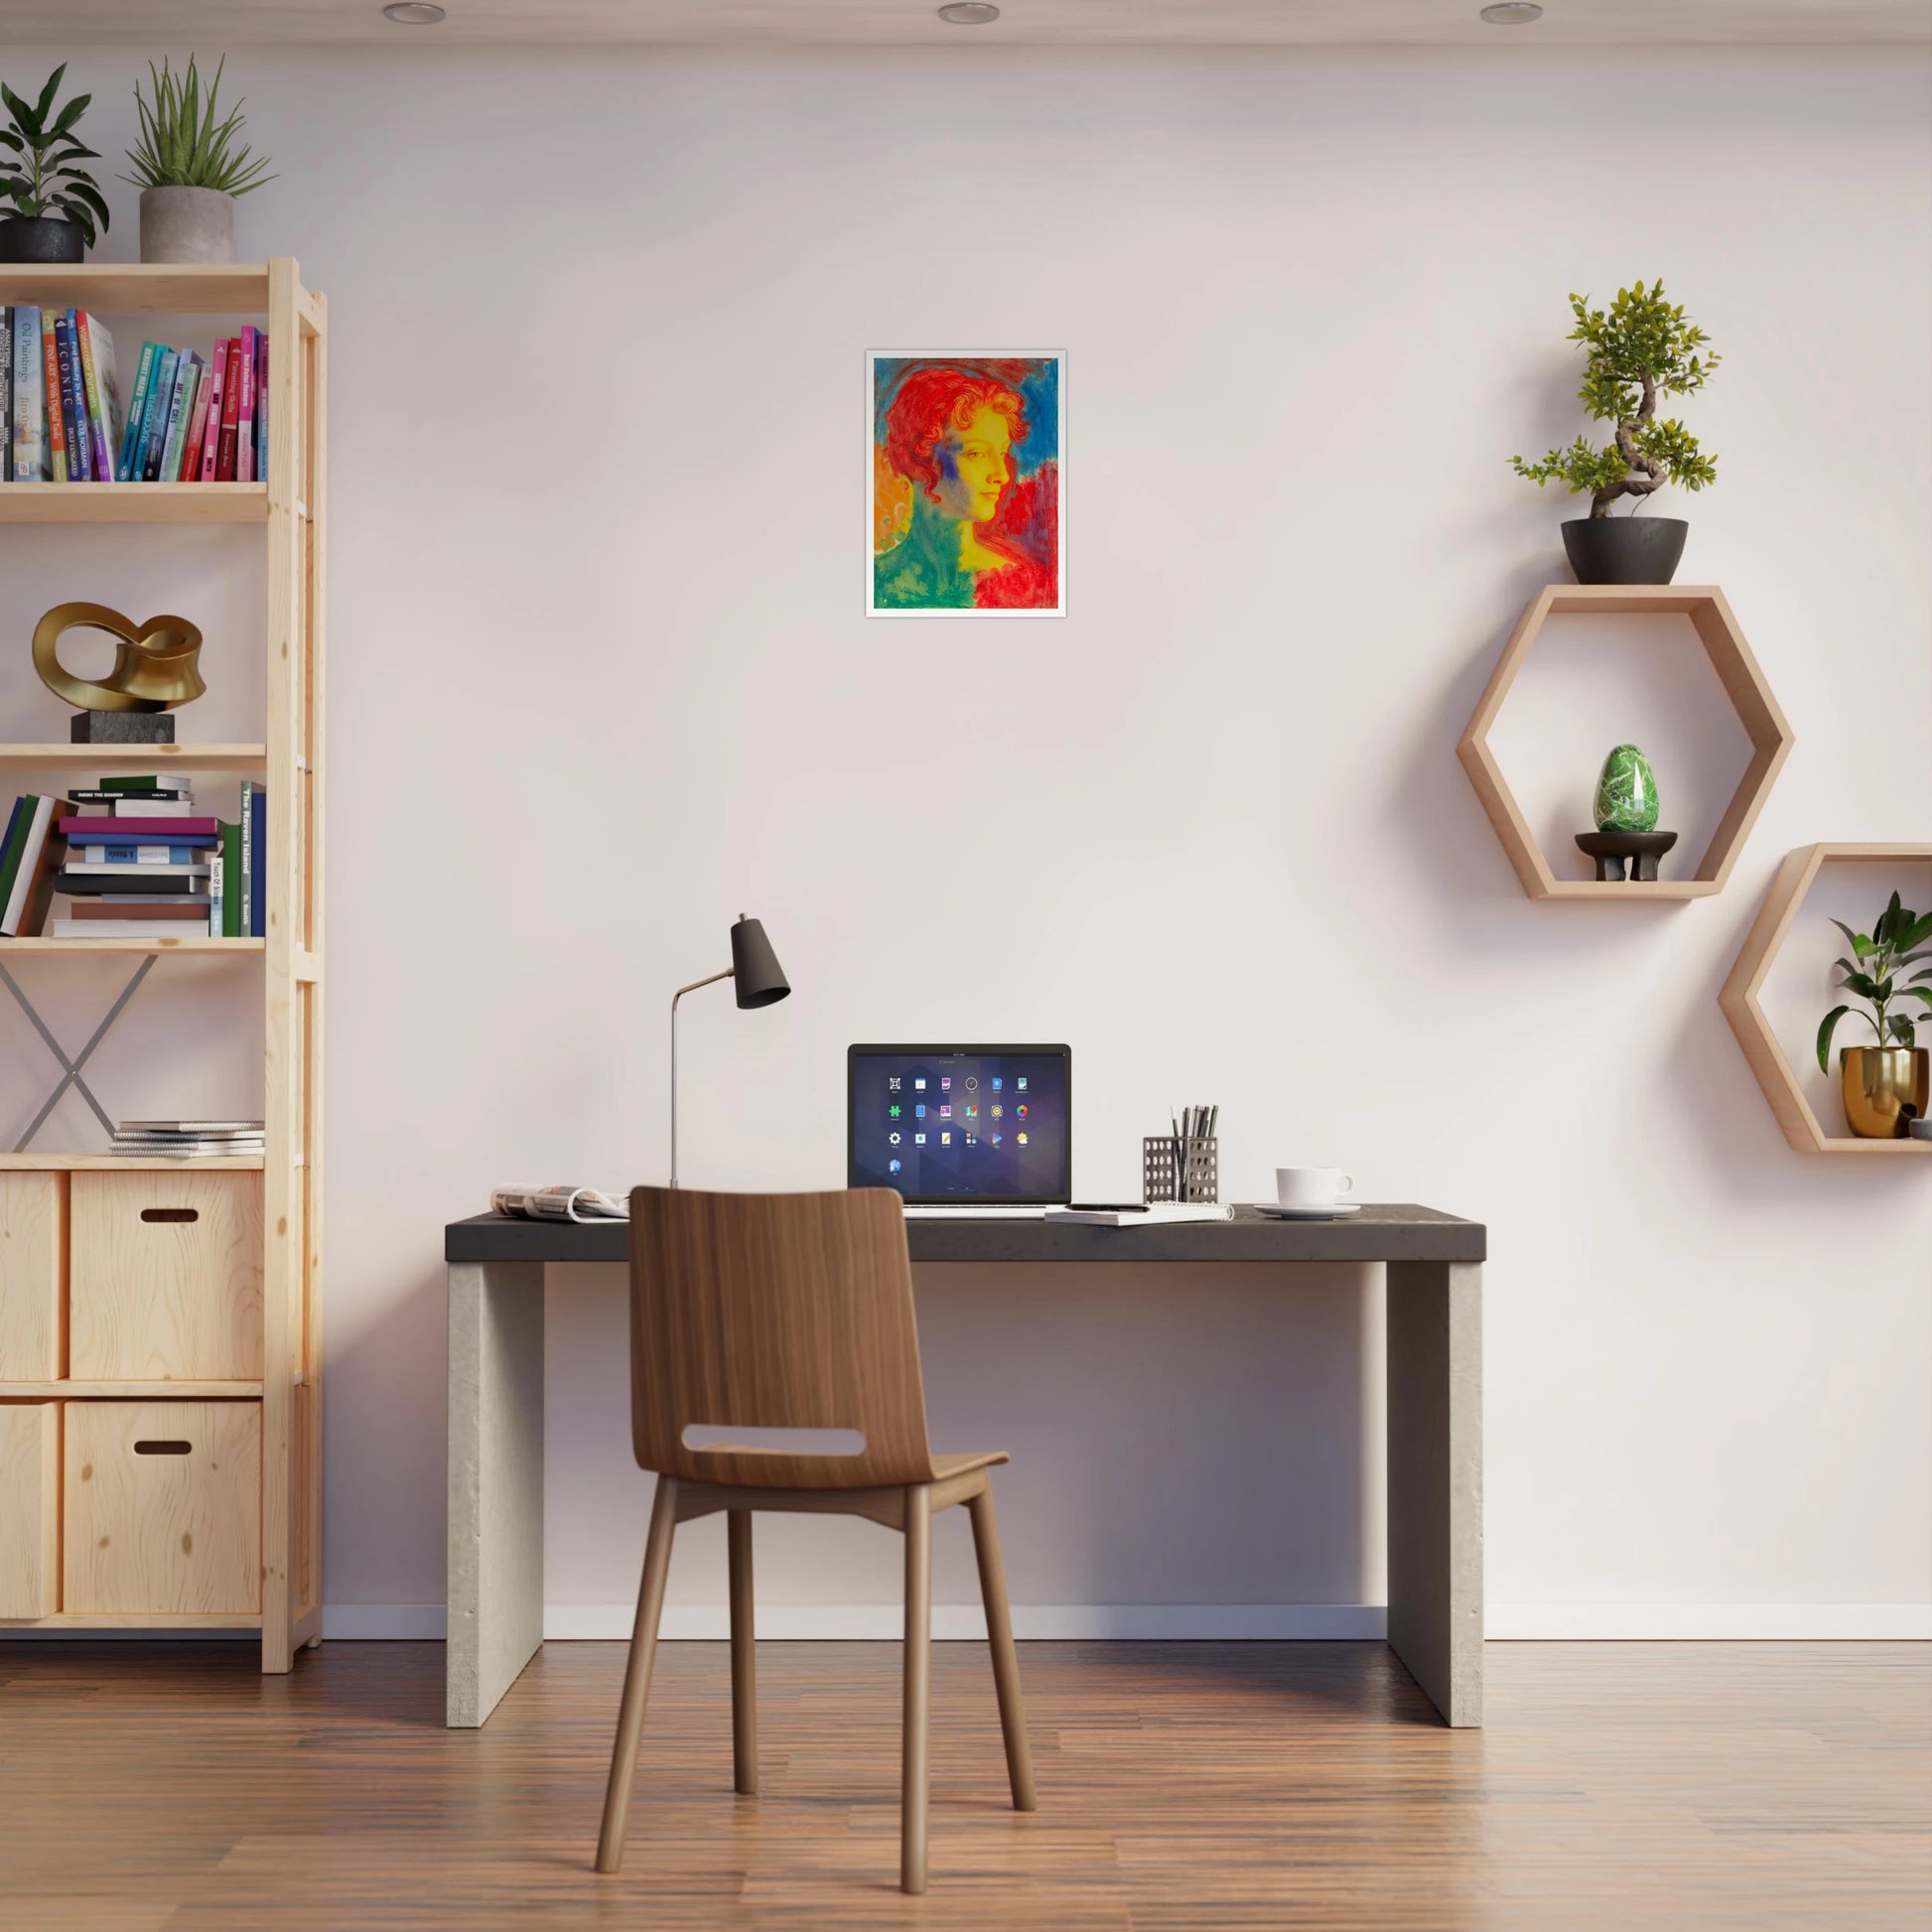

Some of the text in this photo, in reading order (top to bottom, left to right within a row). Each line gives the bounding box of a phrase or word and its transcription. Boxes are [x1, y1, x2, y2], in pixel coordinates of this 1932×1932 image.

[19, 323, 32, 383] Oil Paintings
[72, 356, 81, 381] Beauty
[79, 325, 97, 407] Watercolor Portraits
[50, 383, 59, 397] With
[59, 342, 72, 405] ICONIC
[228, 360, 239, 393] Parenting
[49, 400, 61, 421] Digital
[141, 393, 157, 443] SUCCESSFUL
[53, 422, 62, 440] Tools
